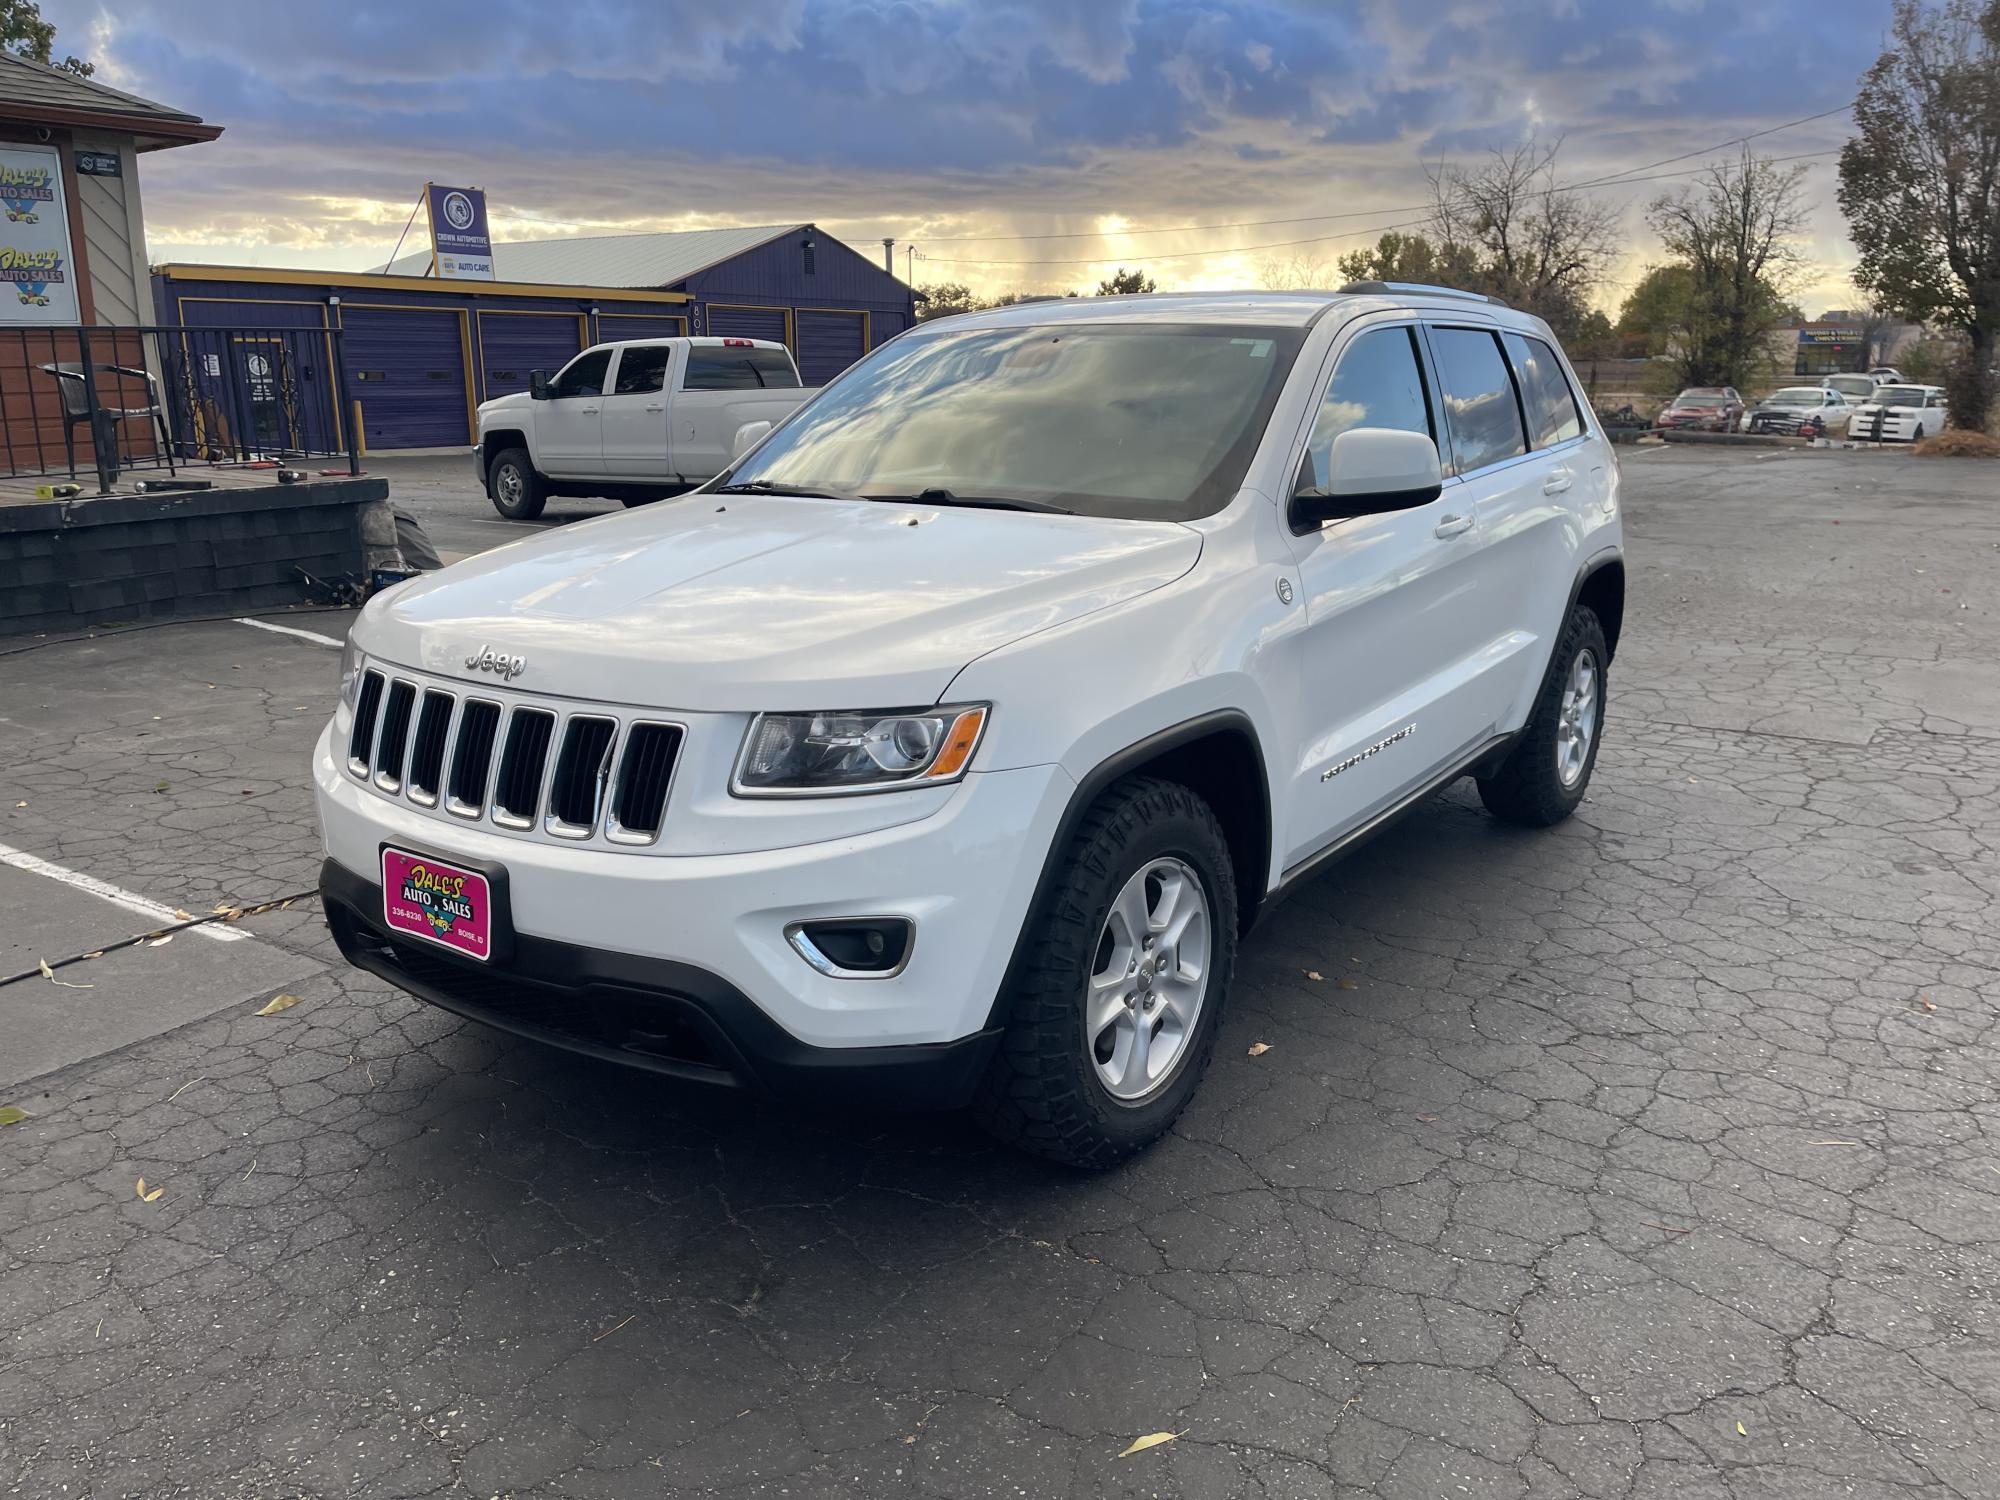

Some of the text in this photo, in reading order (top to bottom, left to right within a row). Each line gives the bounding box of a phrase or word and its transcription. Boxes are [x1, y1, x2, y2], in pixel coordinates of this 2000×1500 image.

[20, 188, 53, 200] SALES
[437, 232, 456, 243] CROWN
[457, 234, 488, 245] AUTOMOTIVE
[458, 262, 474, 272] AUTO
[474, 263, 490, 273] CARE
[0, 270, 63, 282] AUTO SALES
[465, 644, 527, 681] Jeep
[403, 886, 471, 919] AUTO SALES
[391, 906, 422, 922] 336-8230
[476, 934, 484, 944] ID
